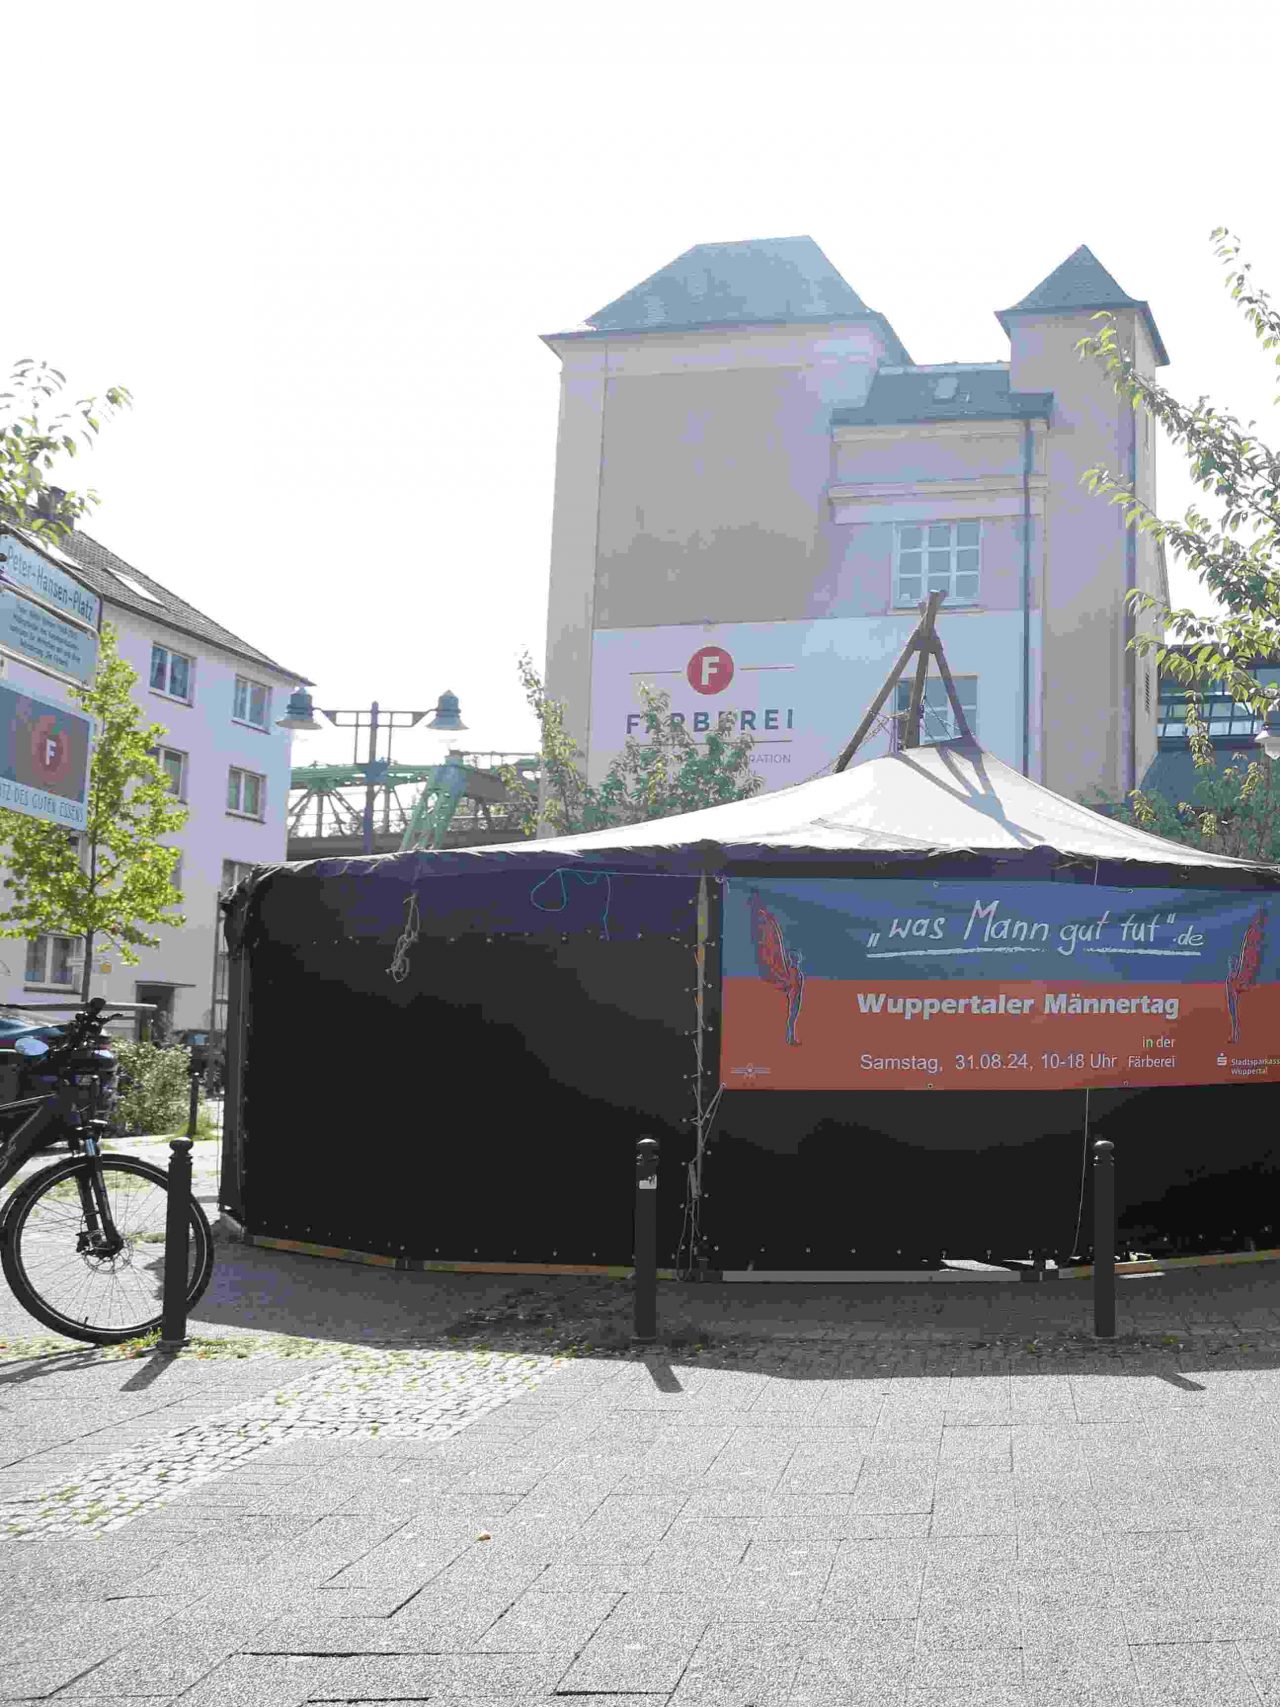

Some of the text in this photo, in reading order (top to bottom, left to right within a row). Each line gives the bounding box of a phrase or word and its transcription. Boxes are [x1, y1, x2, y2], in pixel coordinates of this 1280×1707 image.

[7, 545, 93, 622] Peter-Hansen-Platz
[701, 656, 720, 685] F
[626, 709, 793, 734] FRBEREI
[45, 738, 57, 766] F
[749, 753, 791, 764] RATION
[14, 784, 29, 807] DES
[963, 898, 1049, 942] Mann
[1057, 910, 1111, 956] gut
[857, 993, 1180, 1020] Wuppertaler Männertag
[1142, 1036, 1176, 1048] in der
[860, 1053, 1118, 1073] Samstag, 31.08.24, 10-18 Uhr
[1128, 1055, 1176, 1068] Färberei
